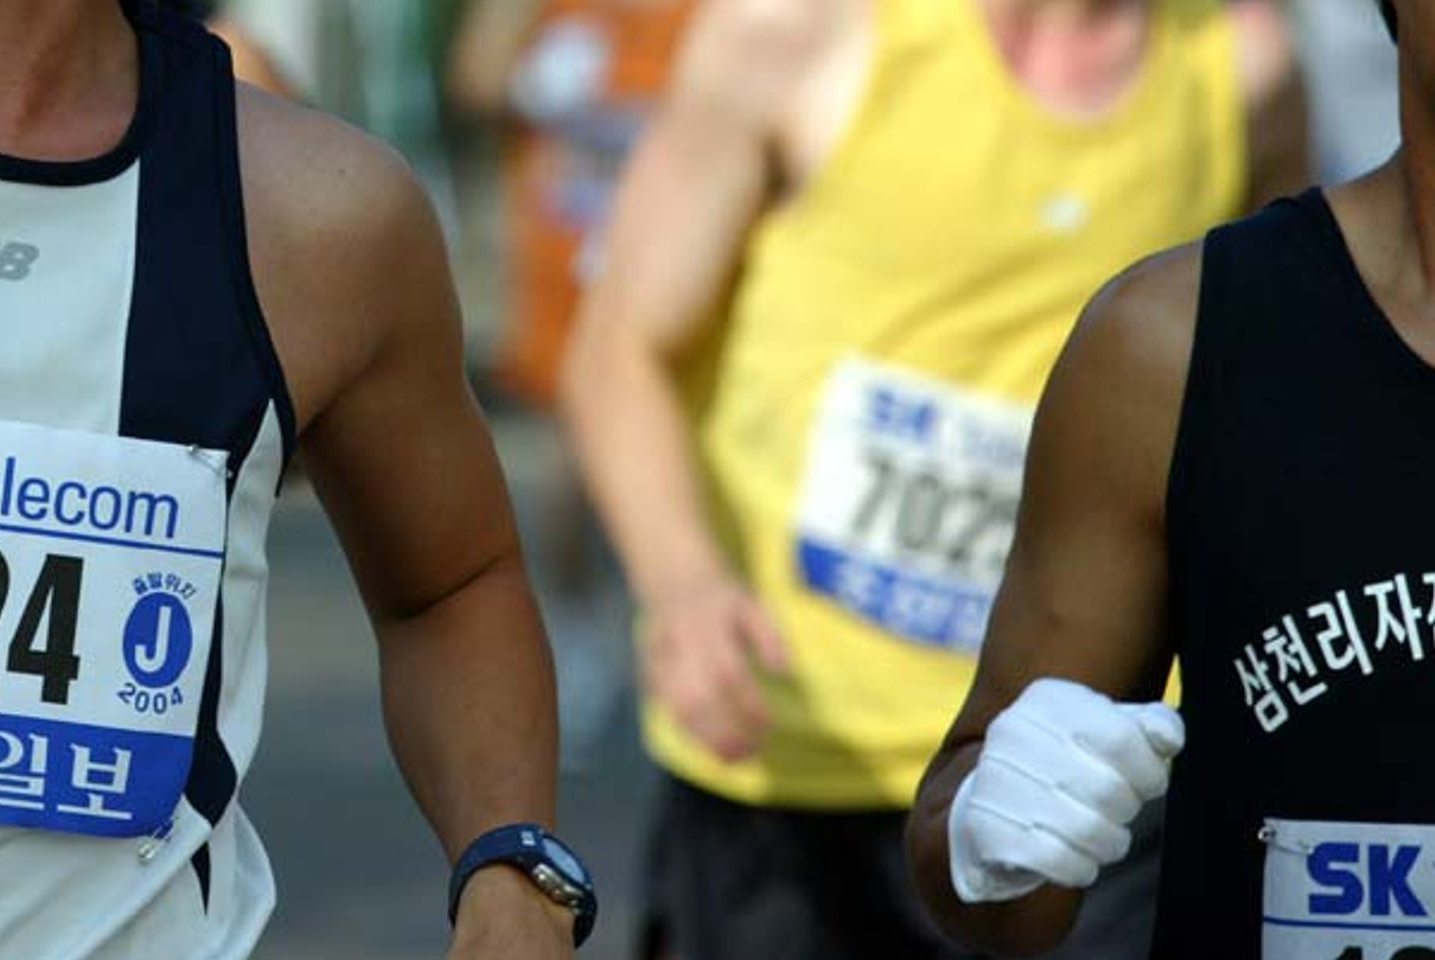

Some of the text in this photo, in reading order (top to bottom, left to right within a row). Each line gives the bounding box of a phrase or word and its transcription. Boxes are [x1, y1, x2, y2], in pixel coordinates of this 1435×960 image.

[133, 605, 173, 674] J
[1233, 571, 1435, 733] 삼천리자
[116, 682, 184, 715] 2004
[1306, 842, 1428, 917] SK
